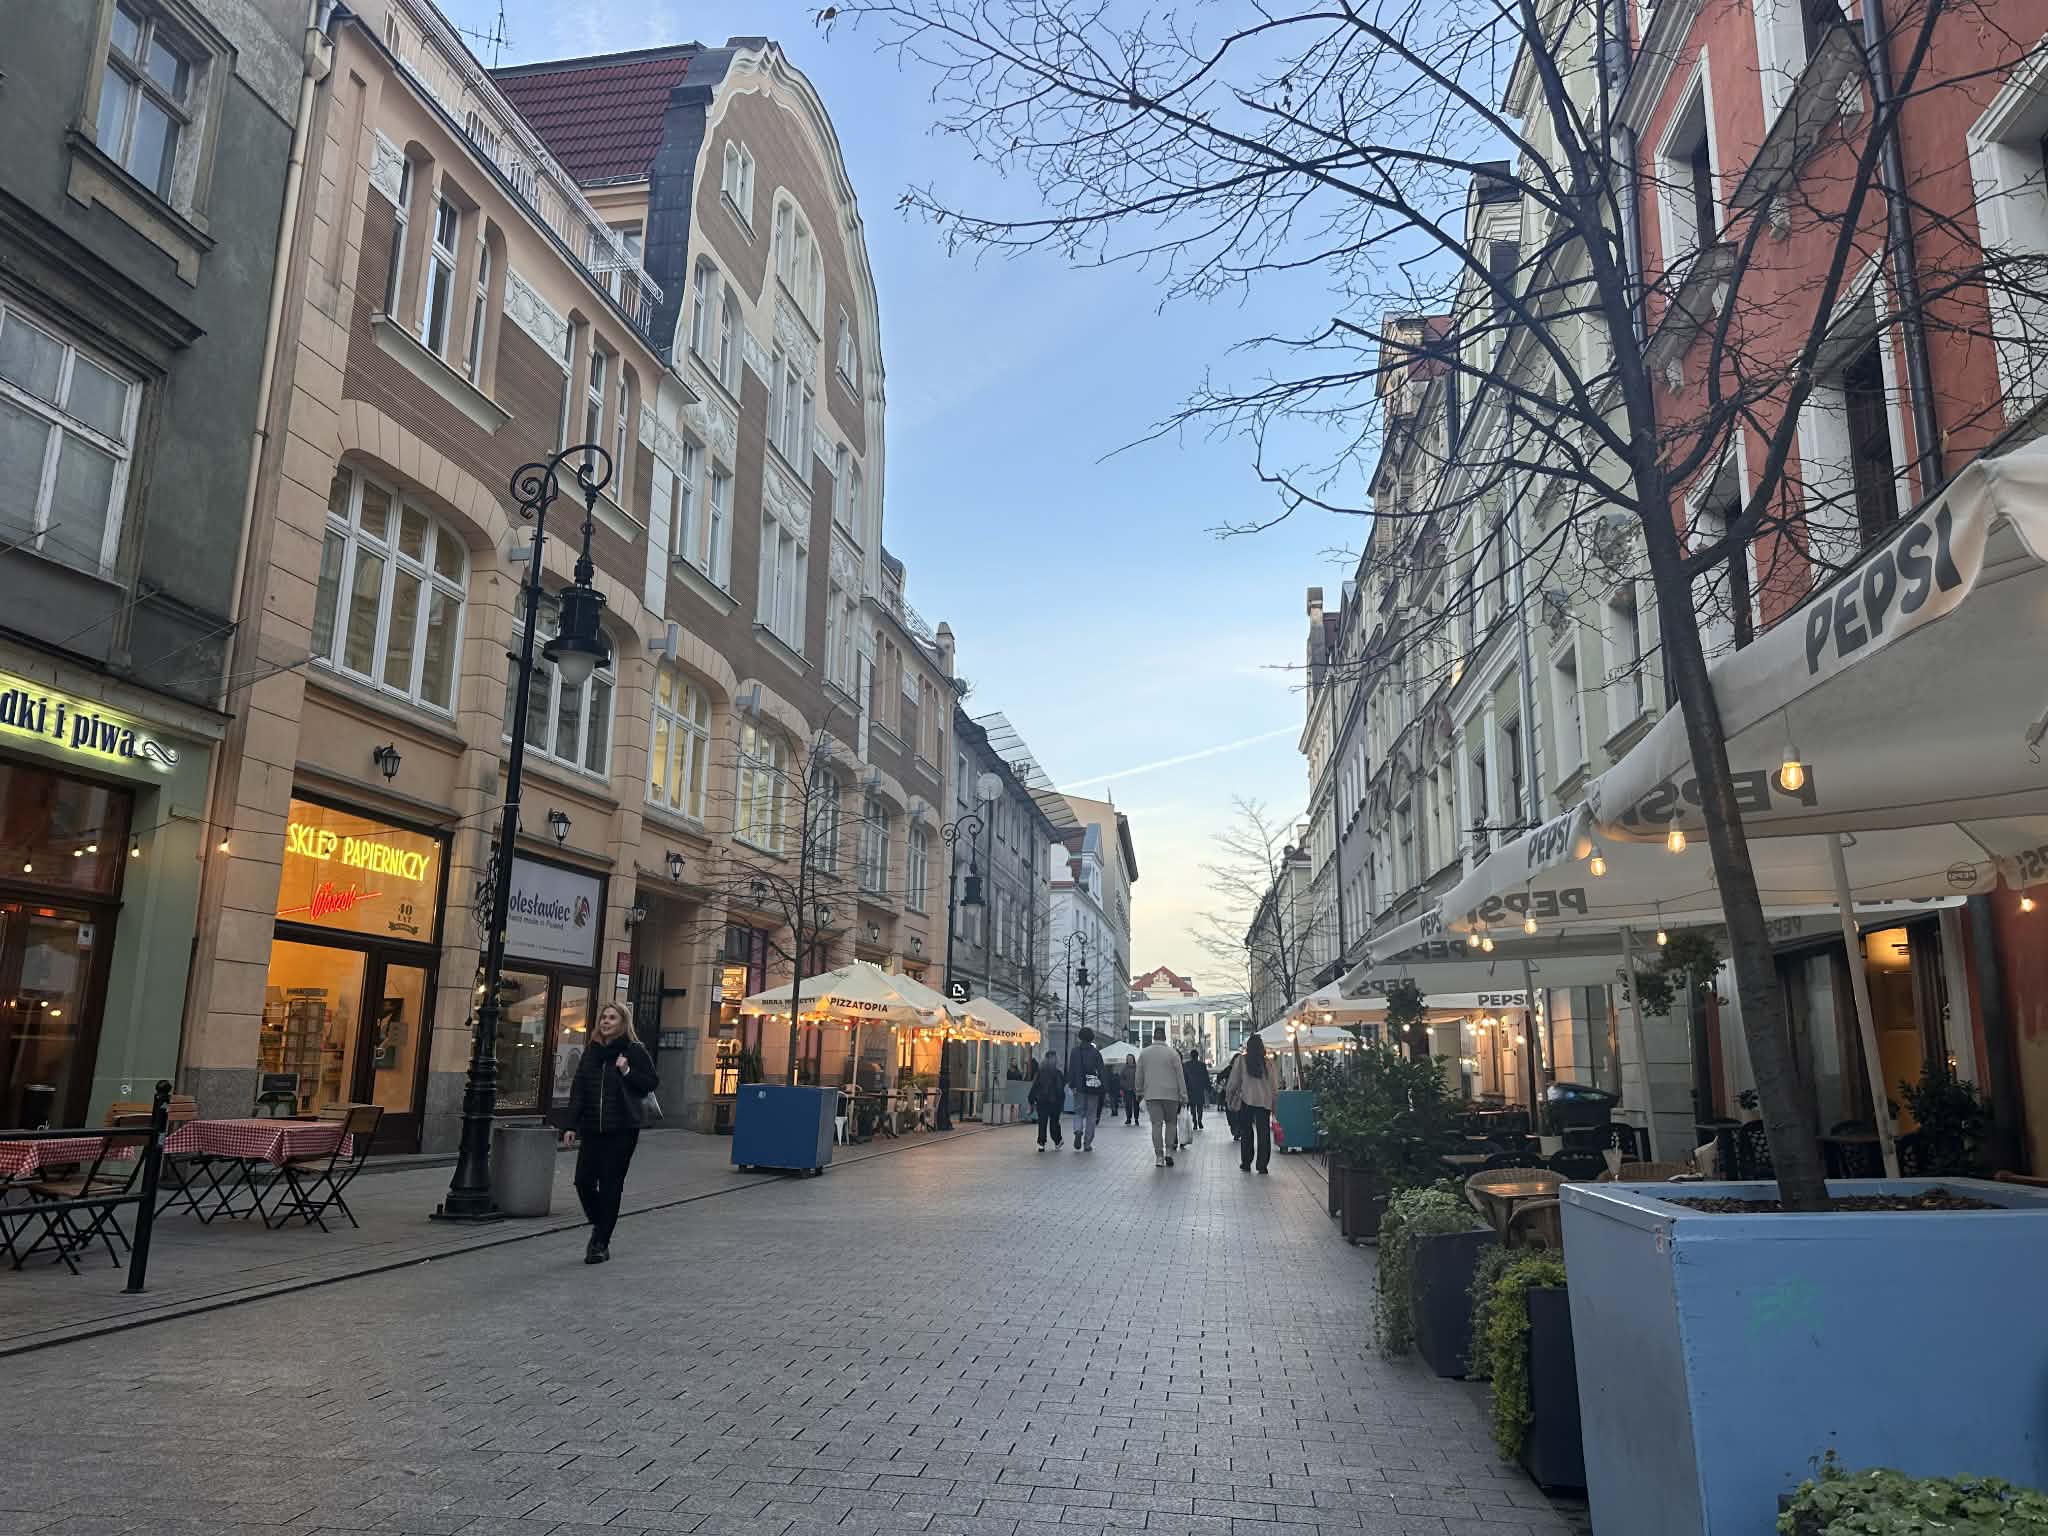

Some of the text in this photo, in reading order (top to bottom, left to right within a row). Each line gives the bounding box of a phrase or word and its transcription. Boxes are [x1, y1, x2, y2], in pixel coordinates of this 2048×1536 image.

[1805, 500, 1962, 675] PEPSI
[53, 703, 65, 738] i
[70, 713, 137, 758] piwa
[286, 822, 430, 881] SKLEP PAPIERNICZY
[1528, 814, 1572, 868] PEPSI
[509, 888, 570, 922] olesławiec
[784, 997, 816, 1005] METTI
[829, 997, 888, 1013] PIZZATOPIA
